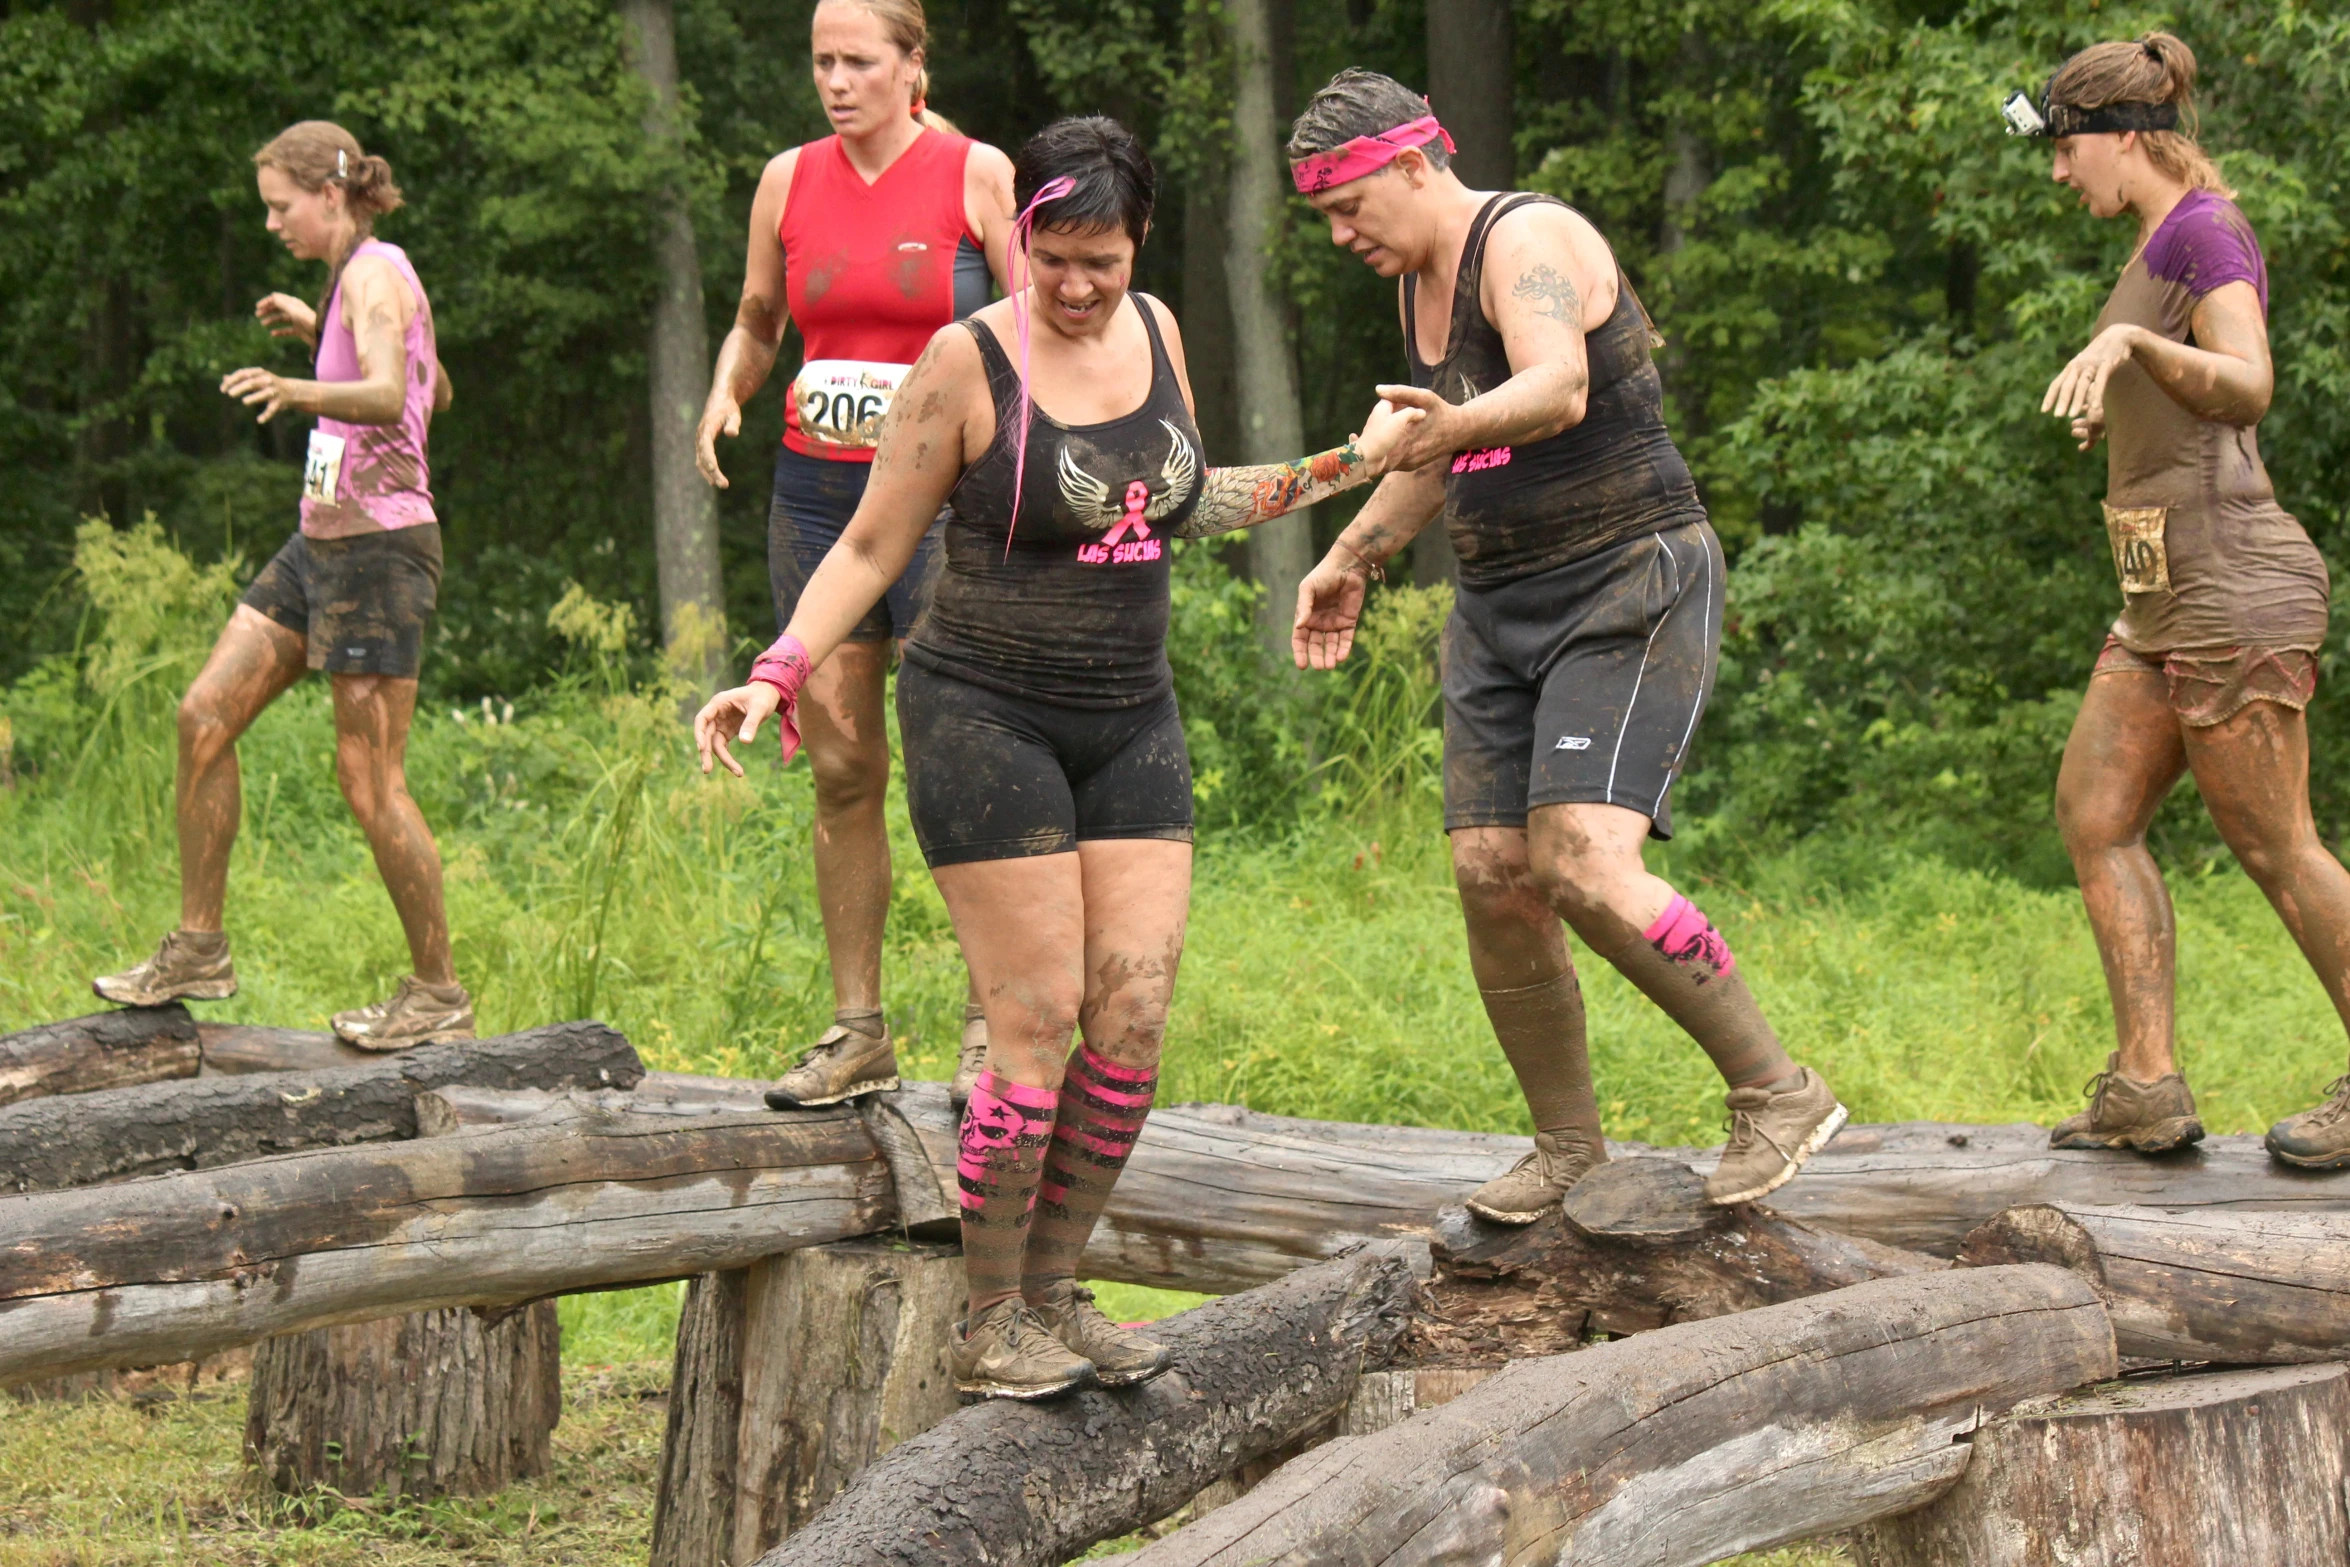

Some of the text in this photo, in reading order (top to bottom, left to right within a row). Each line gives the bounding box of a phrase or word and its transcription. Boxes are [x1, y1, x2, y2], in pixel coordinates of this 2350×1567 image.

[831, 376, 893, 391] DIRTY GIRL
[1077, 543, 1110, 564] LAS
[2117, 538, 2158, 586] 40
